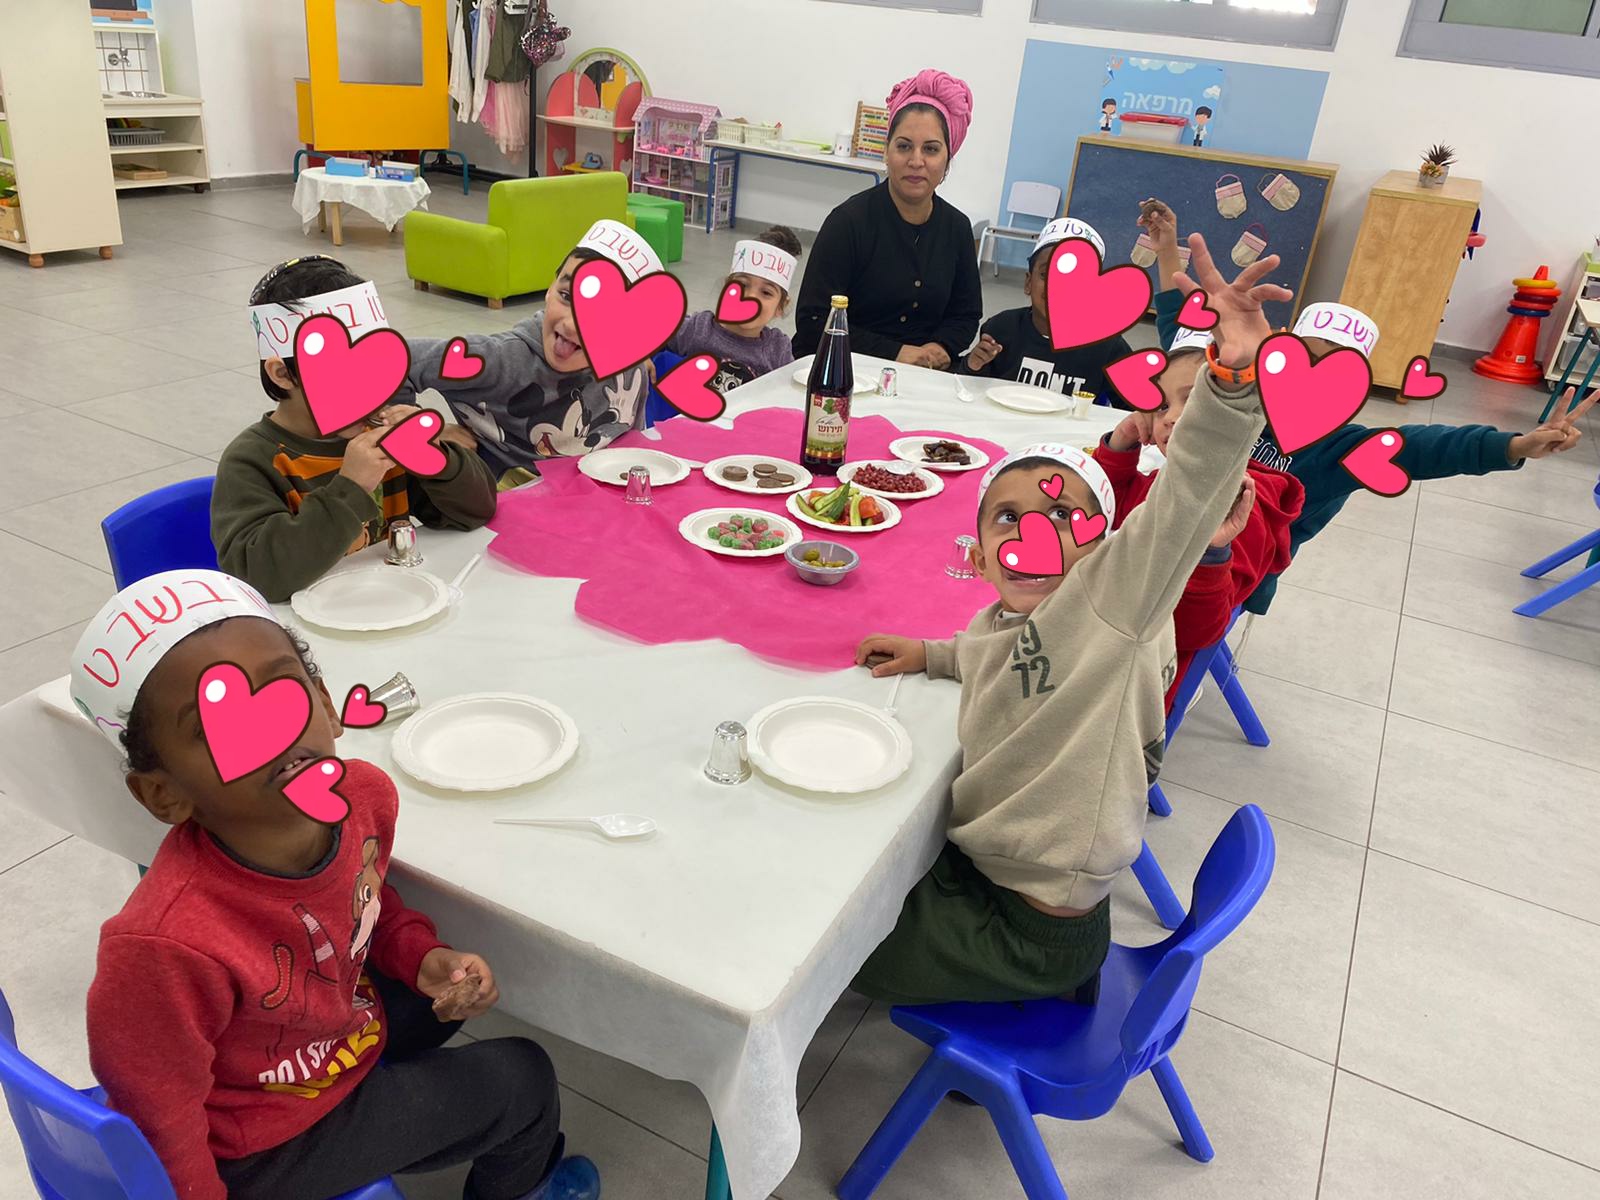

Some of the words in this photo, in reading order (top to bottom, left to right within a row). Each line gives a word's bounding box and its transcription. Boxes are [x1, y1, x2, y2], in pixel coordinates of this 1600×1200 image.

[1121, 91, 1194, 115] מרפאה
[588, 226, 650, 278] בשבט
[751, 249, 792, 281] בשבט
[1313, 309, 1375, 356] בשבט
[1018, 364, 1087, 395] DON'T
[817, 425, 843, 433] תירוש
[83, 580, 238, 688] בשבט
